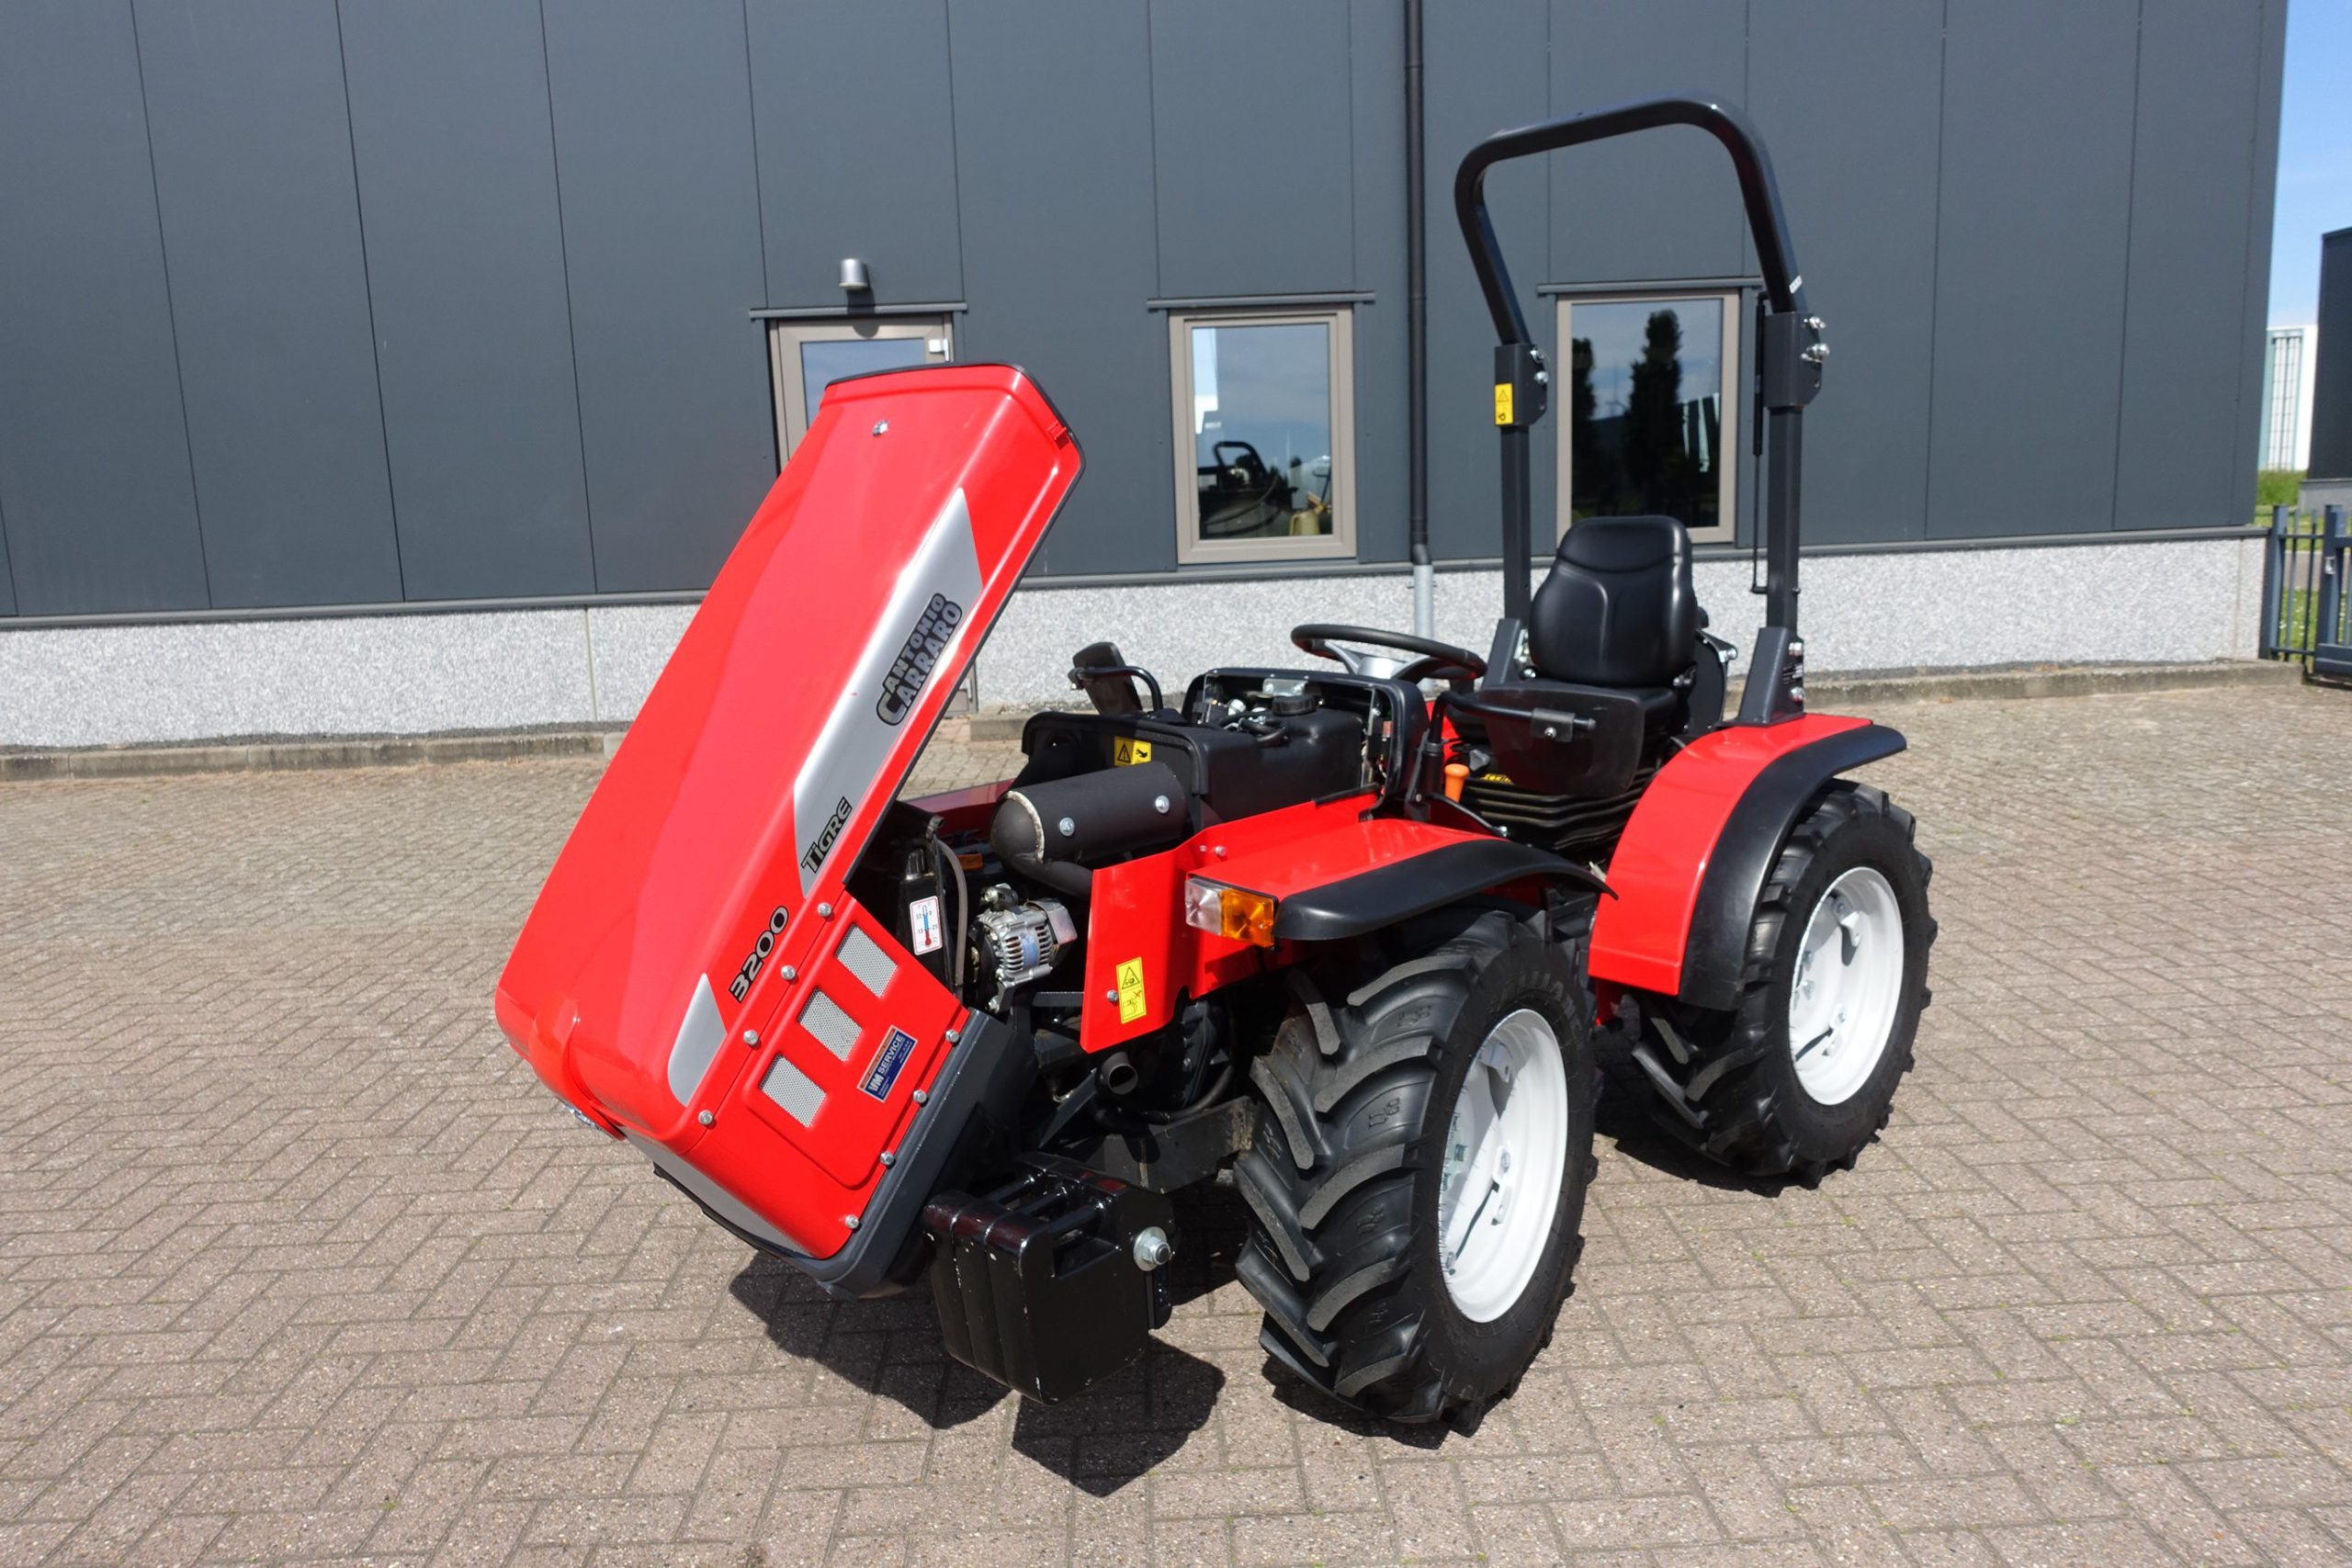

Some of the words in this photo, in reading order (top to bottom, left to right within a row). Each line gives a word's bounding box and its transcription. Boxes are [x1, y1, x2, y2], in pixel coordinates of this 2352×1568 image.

[876, 601, 963, 726] CARRARO
[883, 592, 947, 694] ANTONIO
[729, 905, 789, 1004] 3200
[867, 1073, 885, 1092] VM
[877, 1034, 903, 1074] SERVICE
